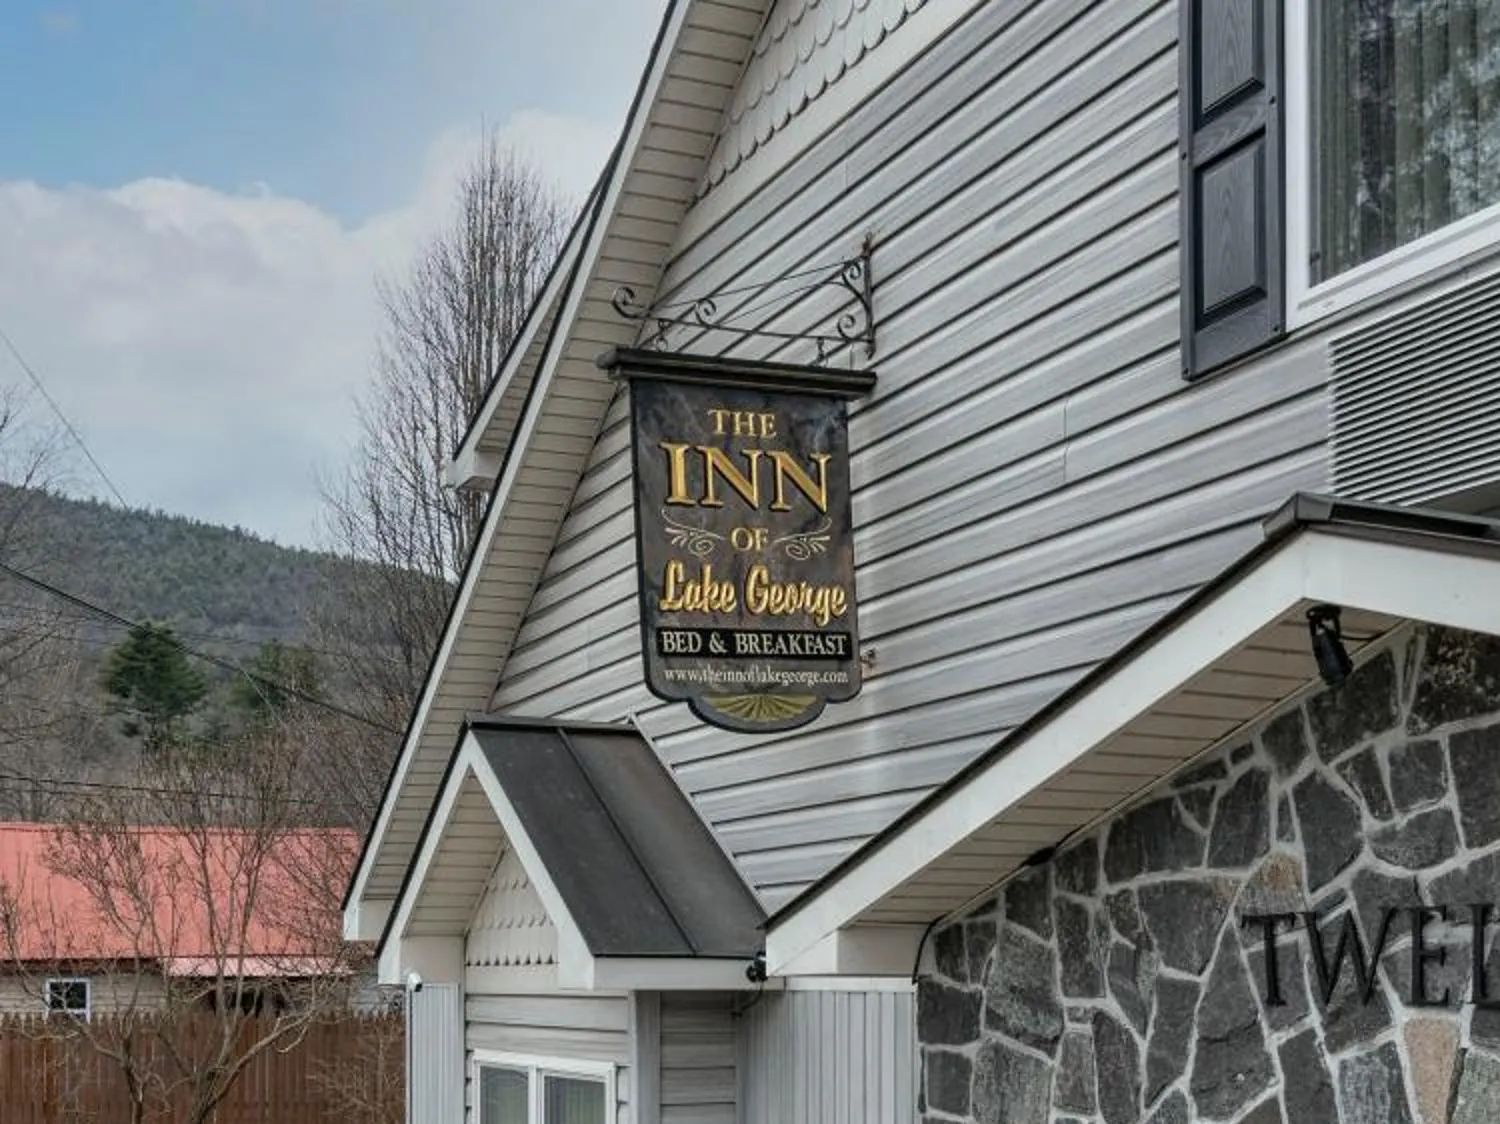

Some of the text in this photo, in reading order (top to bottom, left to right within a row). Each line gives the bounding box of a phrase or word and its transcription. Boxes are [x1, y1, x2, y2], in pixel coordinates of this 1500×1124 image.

[707, 408, 777, 438] THE
[658, 440, 832, 513] INN
[731, 527, 770, 552] OF
[660, 559, 848, 627] Lake George
[662, 631, 847, 656] BED & BREAKFAST
[664, 664, 849, 687] www.theinnoflakegeorge.com
